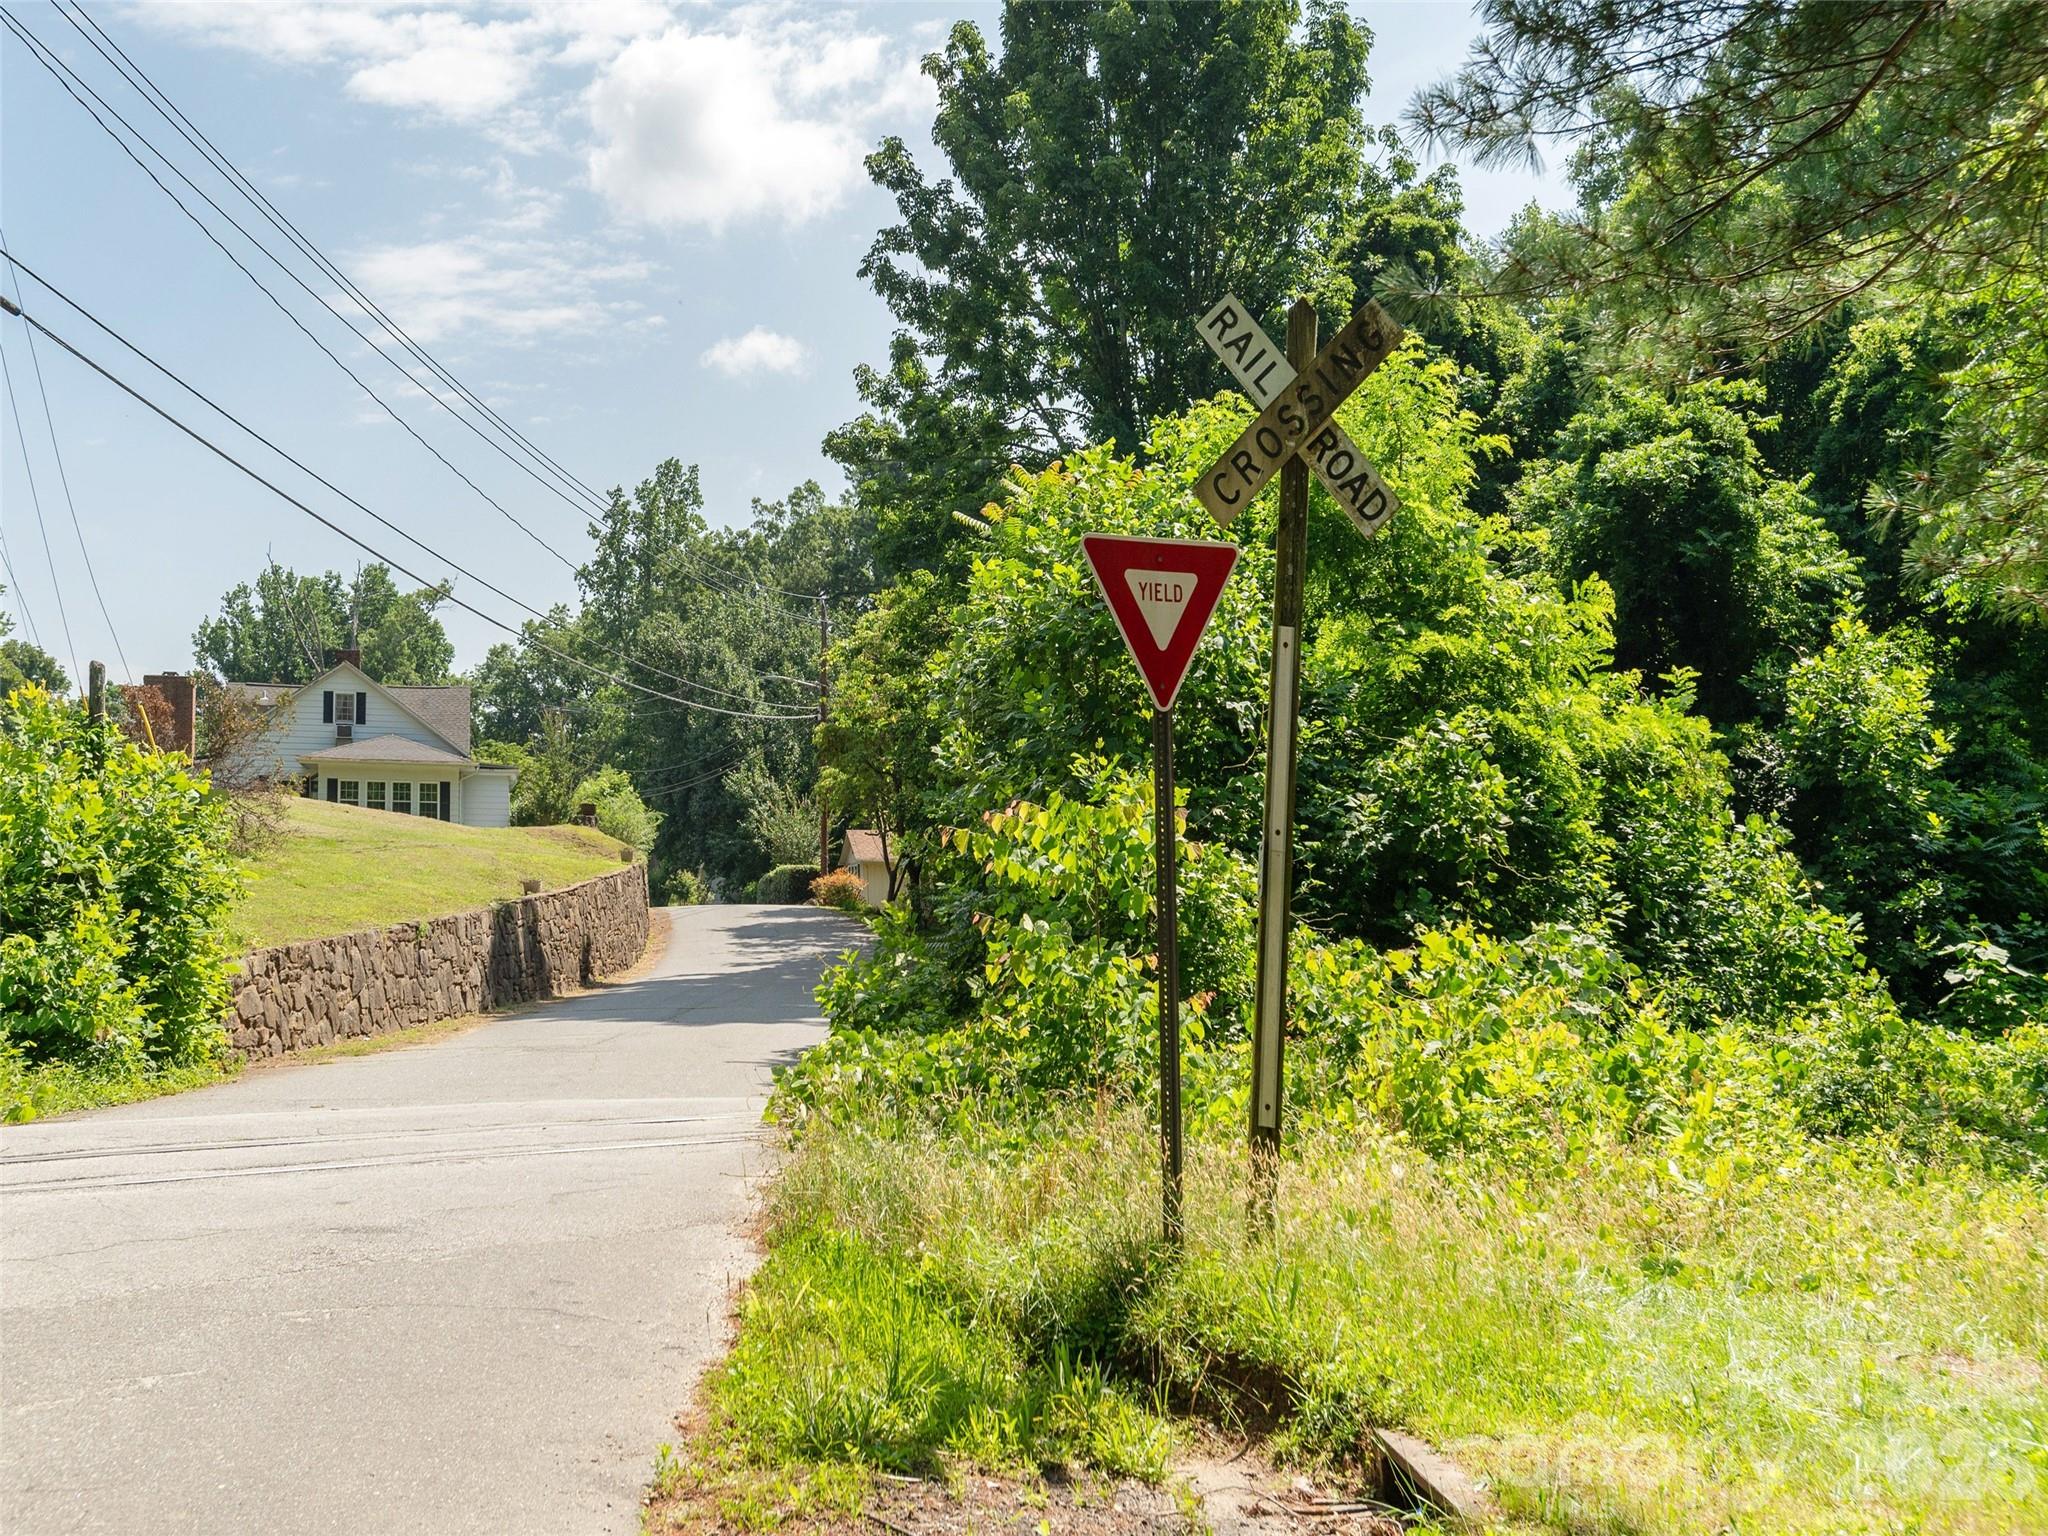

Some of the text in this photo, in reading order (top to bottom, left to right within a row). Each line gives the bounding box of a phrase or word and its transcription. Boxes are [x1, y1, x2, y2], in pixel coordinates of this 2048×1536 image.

[1207, 305, 1277, 397] RAIL
[1213, 321, 1384, 505] CROSSING
[1307, 427, 1387, 521] ROAD
[1139, 582, 1183, 603] YIELD
